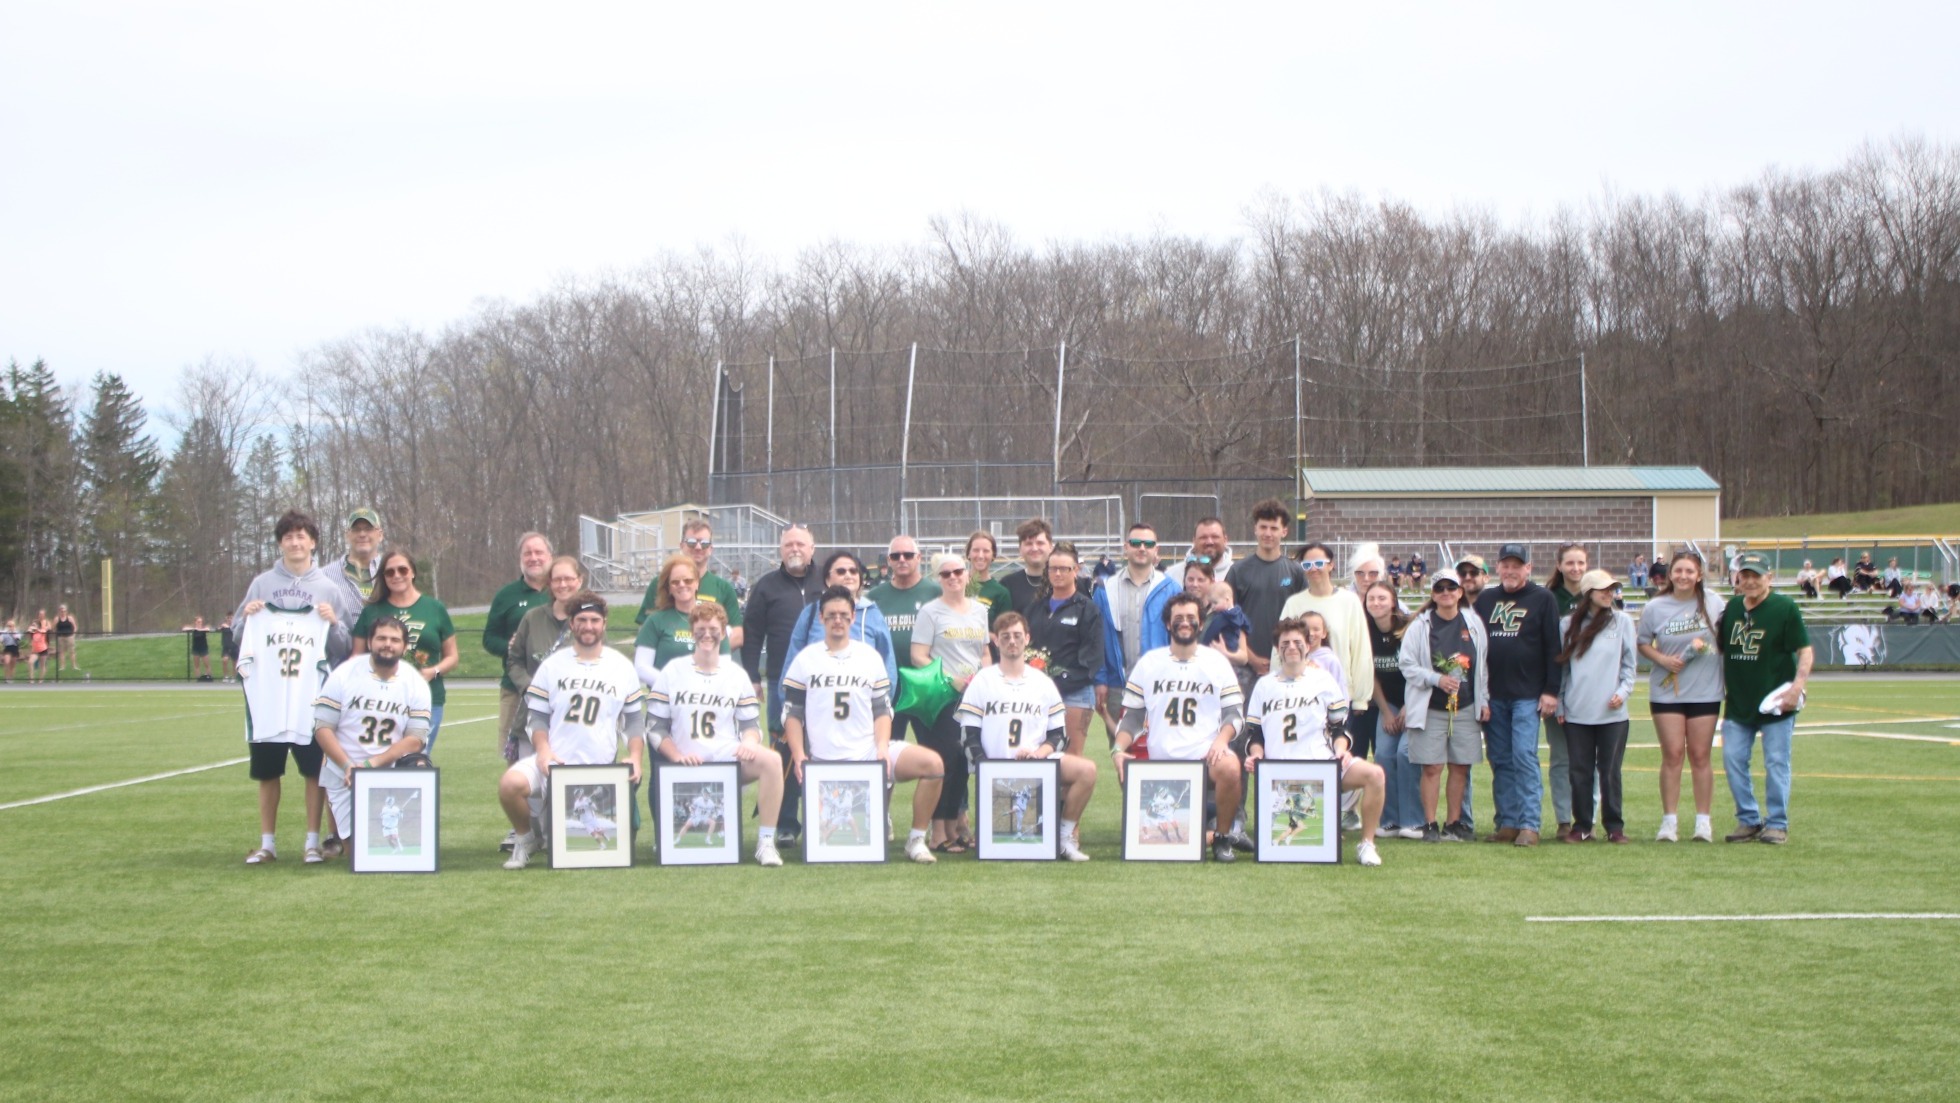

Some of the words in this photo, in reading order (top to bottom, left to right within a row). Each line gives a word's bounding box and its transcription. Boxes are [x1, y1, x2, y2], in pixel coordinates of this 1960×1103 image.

[273, 588, 313, 603] NIAGARA
[1489, 601, 1527, 632] KC
[266, 633, 315, 647] KEUKA
[1730, 622, 1765, 654] KC
[278, 647, 302, 678] 32
[557, 677, 618, 697] KEUKA
[810, 674, 874, 689] KEUKA
[1152, 679, 1214, 695] KEUKA
[348, 695, 411, 717] KEUKA
[563, 693, 601, 726] 20
[674, 690, 737, 708] KEUKA
[833, 691, 850, 722] 5
[985, 700, 1041, 717] KEUKA
[1164, 696, 1198, 728] 46
[1262, 696, 1320, 716] KEUKA
[358, 715, 396, 748] 32
[690, 709, 716, 740] 16
[1008, 718, 1022, 749] 9
[1282, 713, 1298, 744] 2
